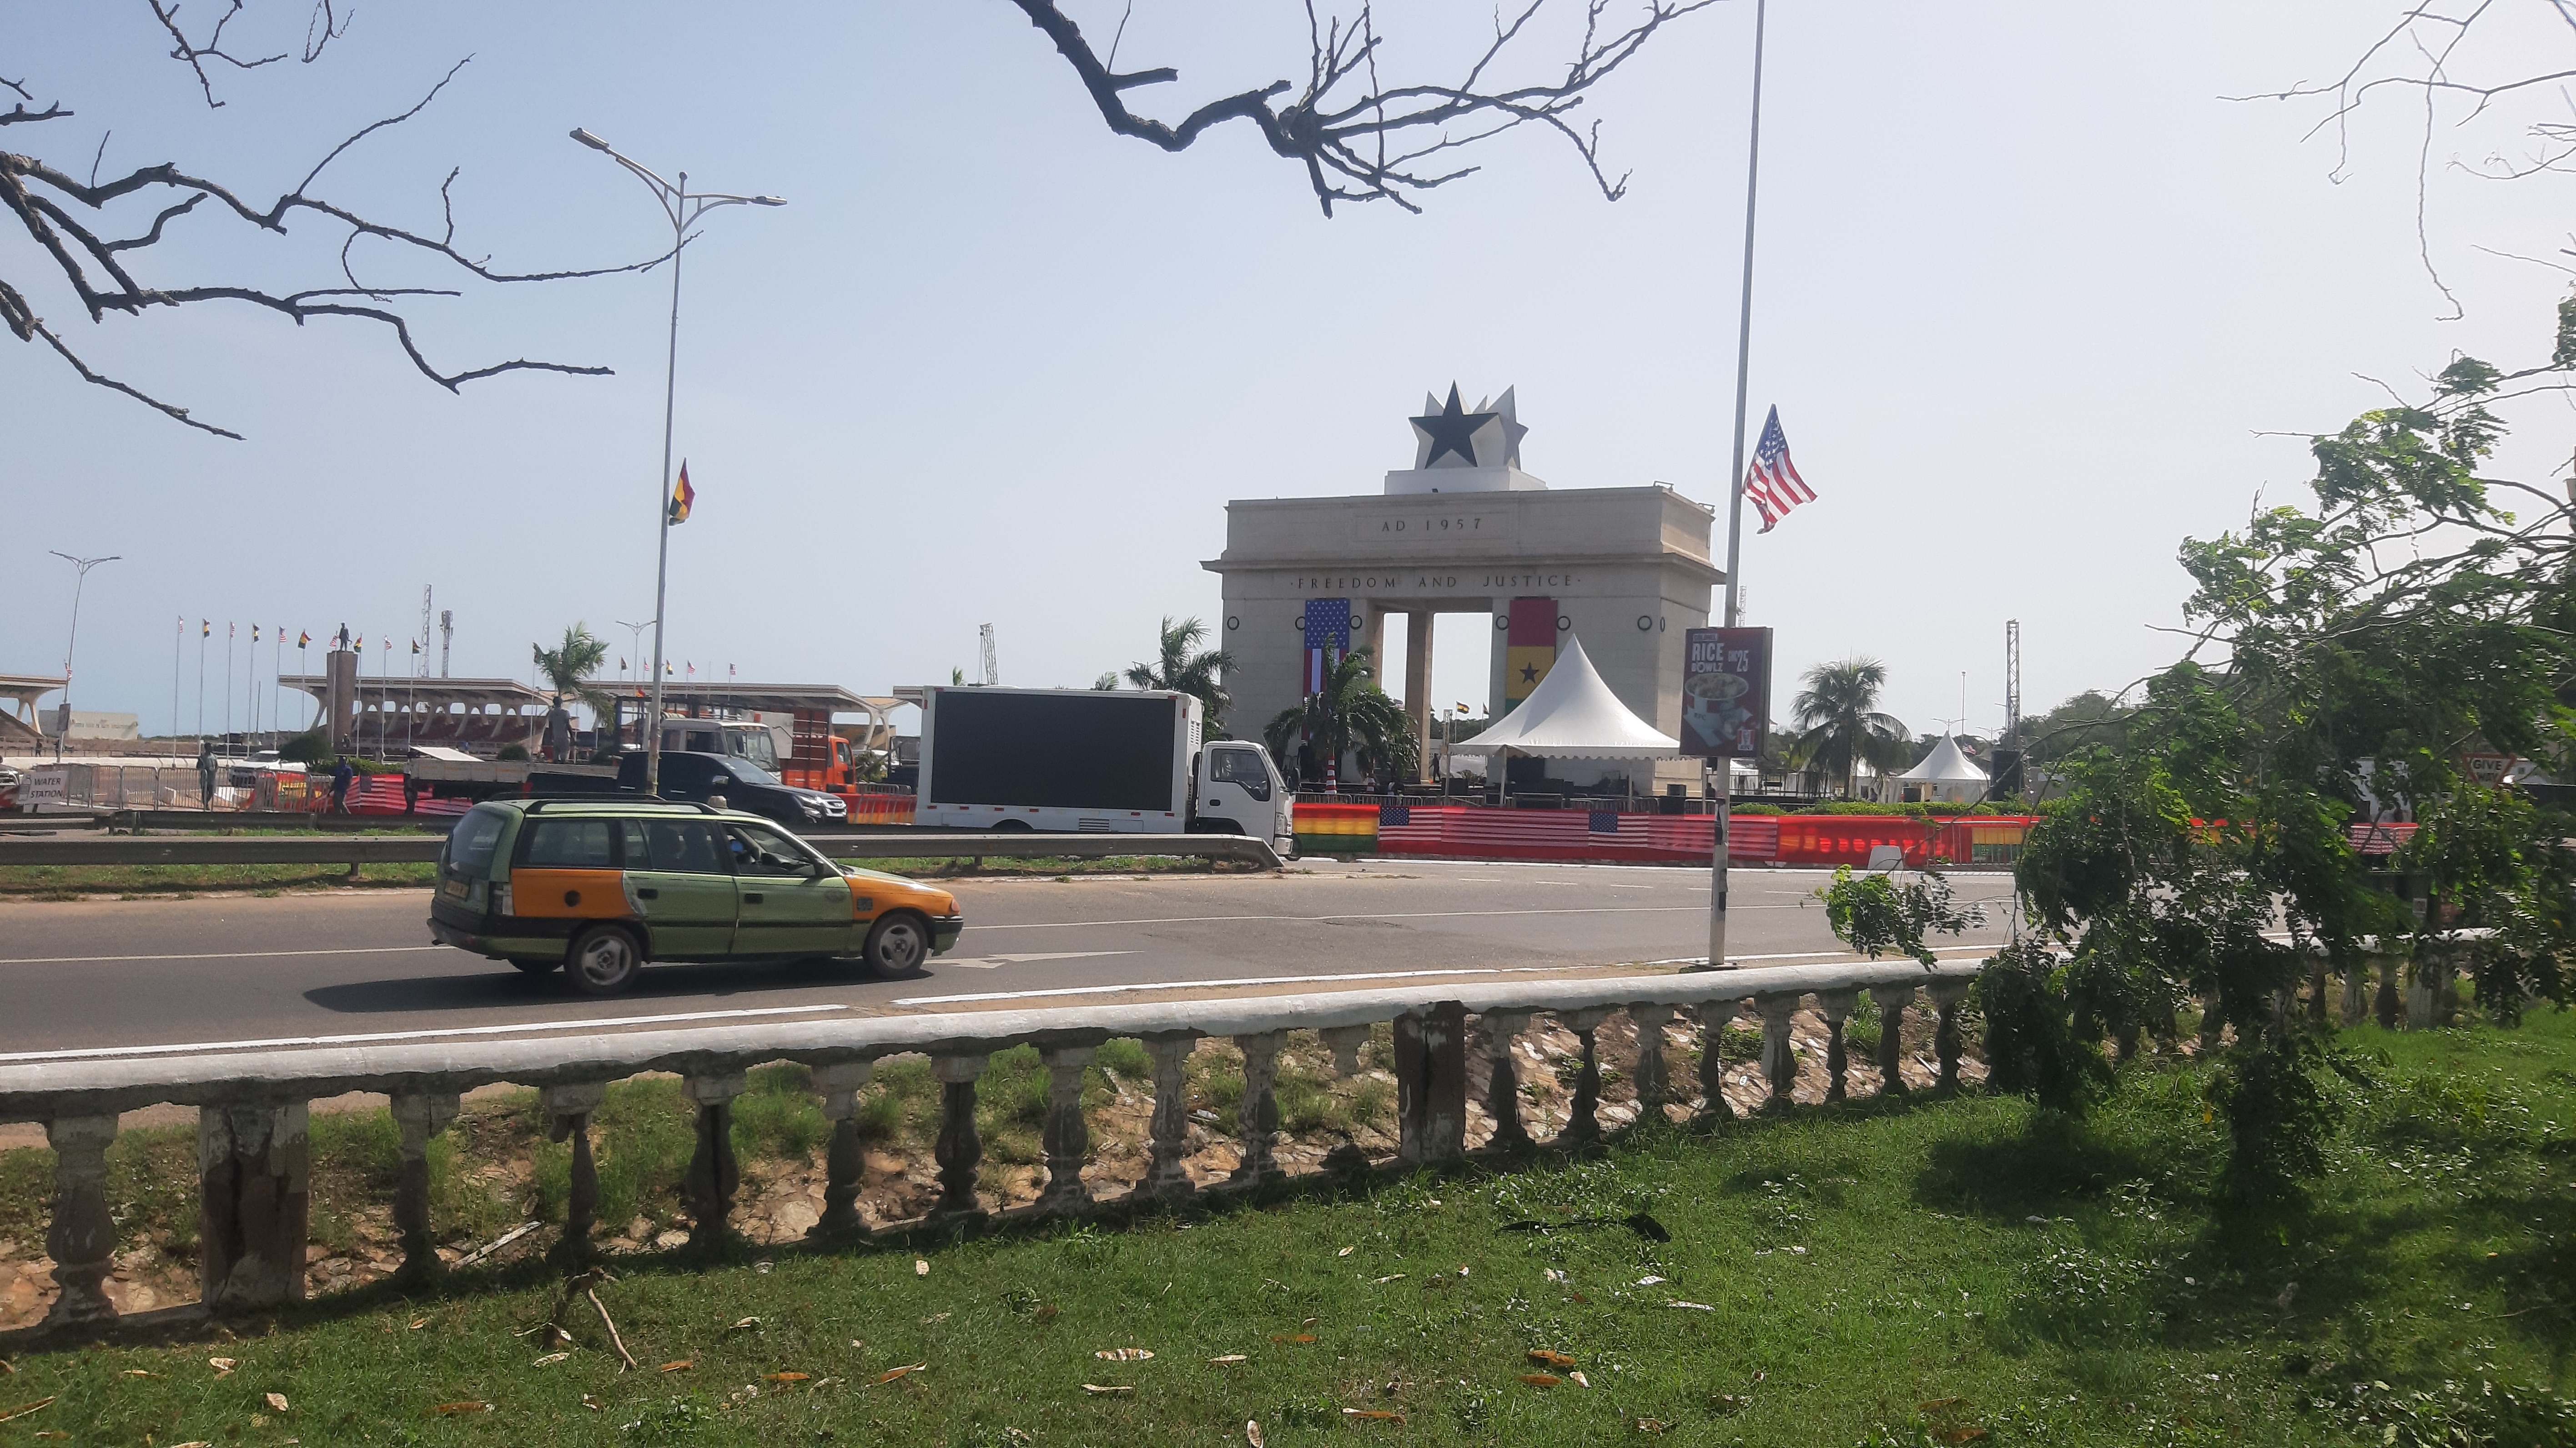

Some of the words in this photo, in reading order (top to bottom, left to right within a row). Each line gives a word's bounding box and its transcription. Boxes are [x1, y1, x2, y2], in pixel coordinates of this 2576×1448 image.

[1382, 520, 1405, 532] AD
[1426, 518, 1481, 531] 1957
[1298, 577, 1395, 588] FREEDOM
[1418, 576, 1457, 588] AND
[1482, 575, 1572, 588] JUSTICE
[1691, 642, 1724, 662] RICE
[1691, 661, 1723, 674] BOWLZ
[2473, 759, 2501, 771] GIVE
[31, 790, 63, 798] STATION
